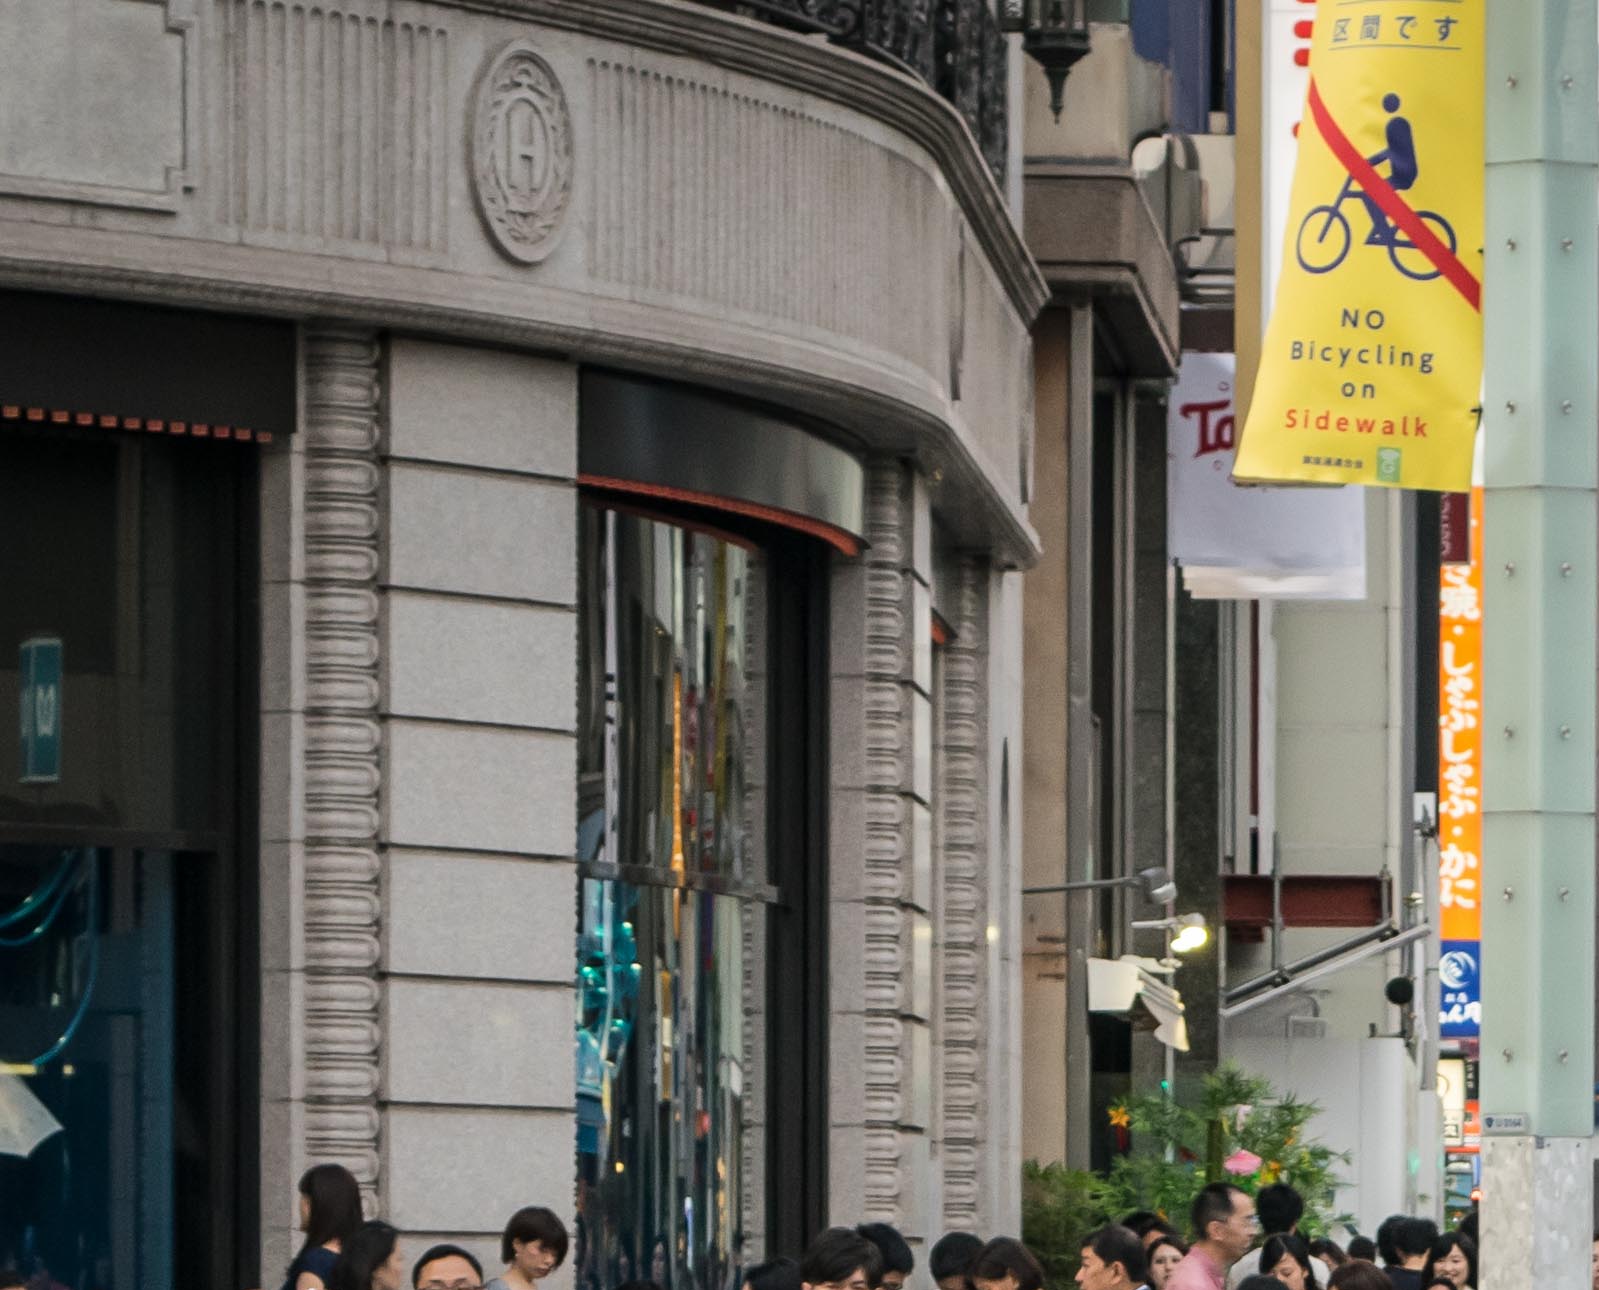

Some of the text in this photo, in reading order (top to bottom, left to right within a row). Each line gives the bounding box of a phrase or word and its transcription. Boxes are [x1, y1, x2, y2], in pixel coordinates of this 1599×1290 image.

[1333, 16, 1458, 42] 区間です
[1341, 309, 1385, 329] NO
[1292, 341, 1434, 374] Bicycling
[1341, 382, 1375, 399] on
[1285, 409, 1427, 438] Sidewalk
